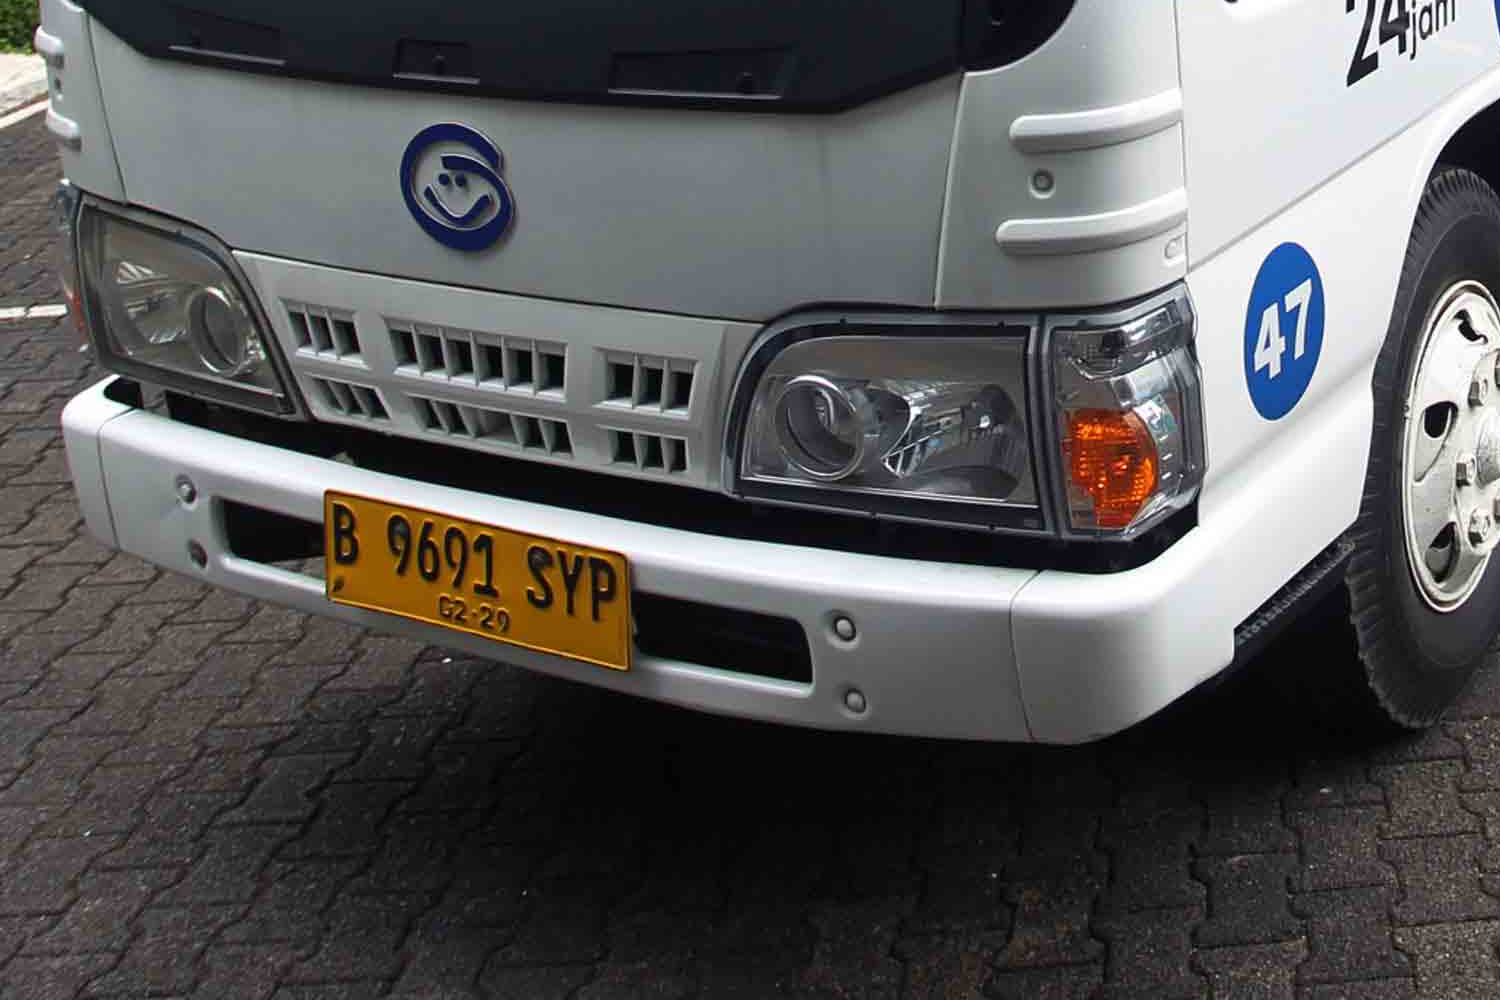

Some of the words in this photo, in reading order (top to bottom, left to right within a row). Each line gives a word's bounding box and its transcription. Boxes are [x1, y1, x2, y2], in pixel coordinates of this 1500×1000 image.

[1254, 277, 1314, 380] 47
[332, 502, 360, 565] B
[386, 513, 499, 599] 9691
[526, 545, 618, 622] SYP
